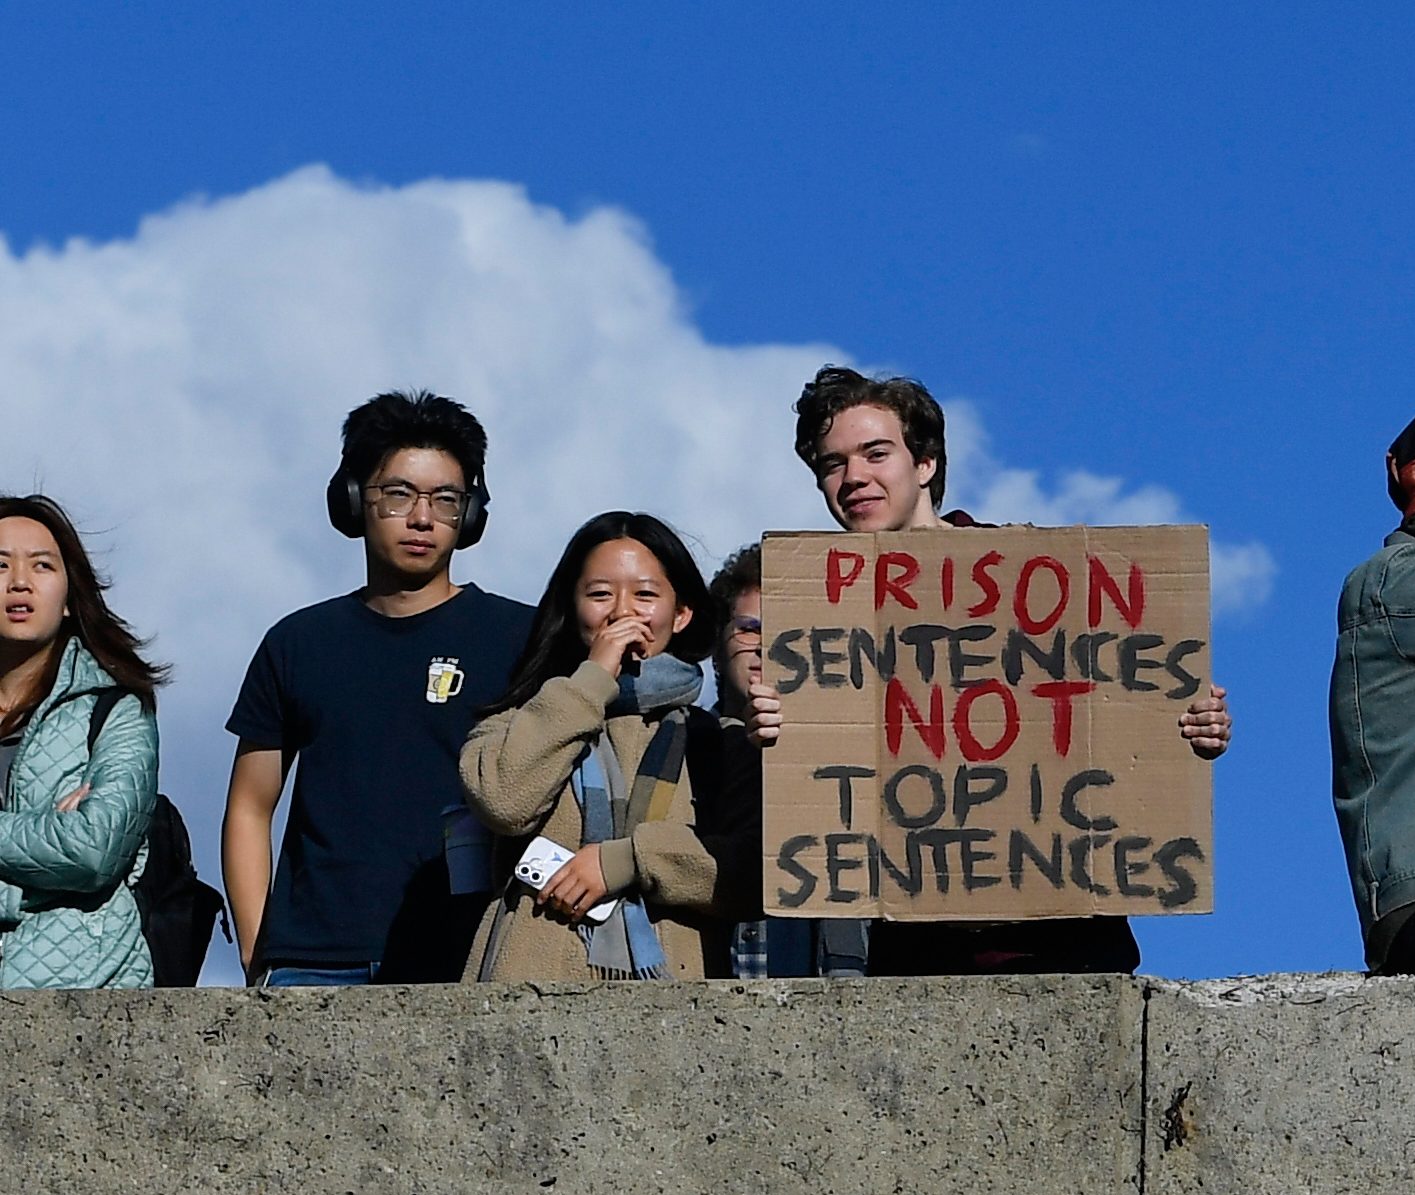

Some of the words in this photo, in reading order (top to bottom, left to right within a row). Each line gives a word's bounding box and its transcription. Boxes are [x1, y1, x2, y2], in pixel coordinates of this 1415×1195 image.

[825, 547, 1146, 634] PRISON
[768, 624, 1206, 700] SENTENCES
[884, 677, 1097, 763] NOT
[811, 763, 1118, 831] TOPIC
[776, 828, 1206, 909] SENTENCES
